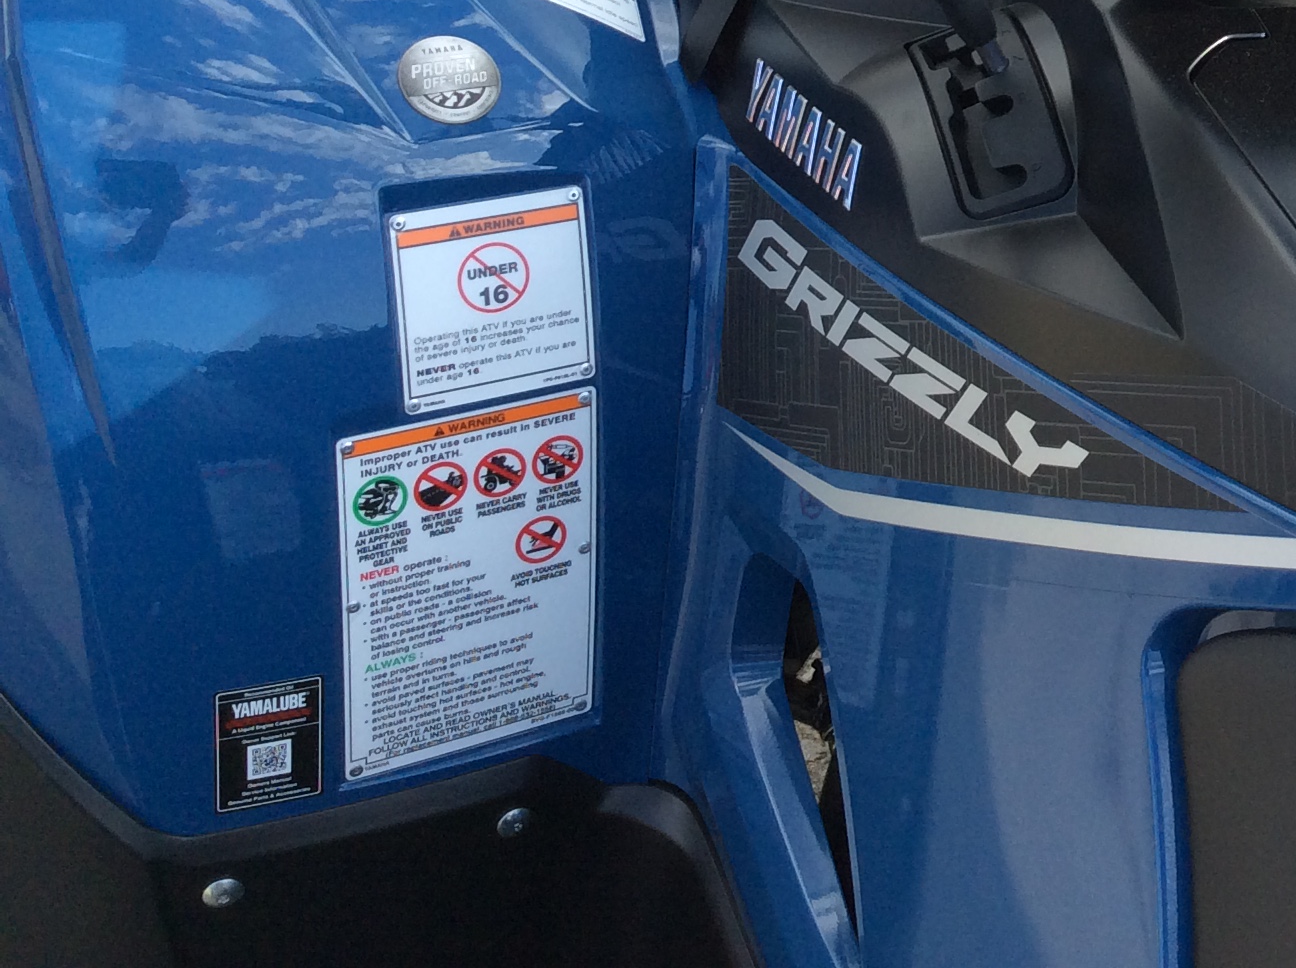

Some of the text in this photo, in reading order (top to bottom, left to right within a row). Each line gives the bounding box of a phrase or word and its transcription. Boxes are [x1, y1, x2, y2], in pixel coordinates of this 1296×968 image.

[421, 45, 463, 54] YAMAHA
[411, 58, 475, 78] PROVEN
[746, 58, 862, 211] YAMAHA
[463, 216, 525, 234] WARNING
[467, 262, 518, 280] UNDER
[479, 284, 509, 306] 16
[414, 309, 572, 346] Operating this ATV if you are under
[414, 317, 579, 353] the age of 16 increases your chance
[415, 336, 528, 362] of severe injury or death.
[738, 219, 1089, 478] GRIZZLY
[416, 340, 576, 377] NEVER operate this ATV if you are
[417, 372, 463, 386] under age
[448, 414, 506, 432] WARNING
[360, 413, 576, 467] Improper ATV use can result in SEVERE
[361, 449, 463, 478] INJURY or DEATH.
[565, 480, 579, 489] USE
[476, 492, 527, 510] NEVER CARRY
[478, 501, 525, 518] PASSENGERS
[536, 503, 546, 512] OR
[421, 507, 463, 523] NEVER USE
[422, 516, 462, 531] ON PUBLIC
[355, 528, 411, 547] AN APPROVED
[358, 521, 407, 538] ALWAYS USE
[430, 526, 455, 537] ROADS
[357, 537, 407, 555] HELMET AND
[359, 545, 408, 562] PROTECTIVE
[360, 557, 442, 581] NEVER operate
[373, 557, 394, 567] GEAR
[369, 559, 471, 589] without proper training
[515, 578, 530, 588] HOT
[381, 592, 413, 605] speeds
[433, 582, 449, 591] fast
[467, 573, 486, 585] your
[371, 625, 387, 634] can
[390, 618, 414, 629] occur
[438, 603, 472, 616] another
[365, 653, 416, 674] ALWAYS
[232, 693, 307, 719] YAMALUBE
[383, 729, 420, 744] LOCATE
[423, 723, 443, 733] AND
[445, 714, 470, 727] READ
